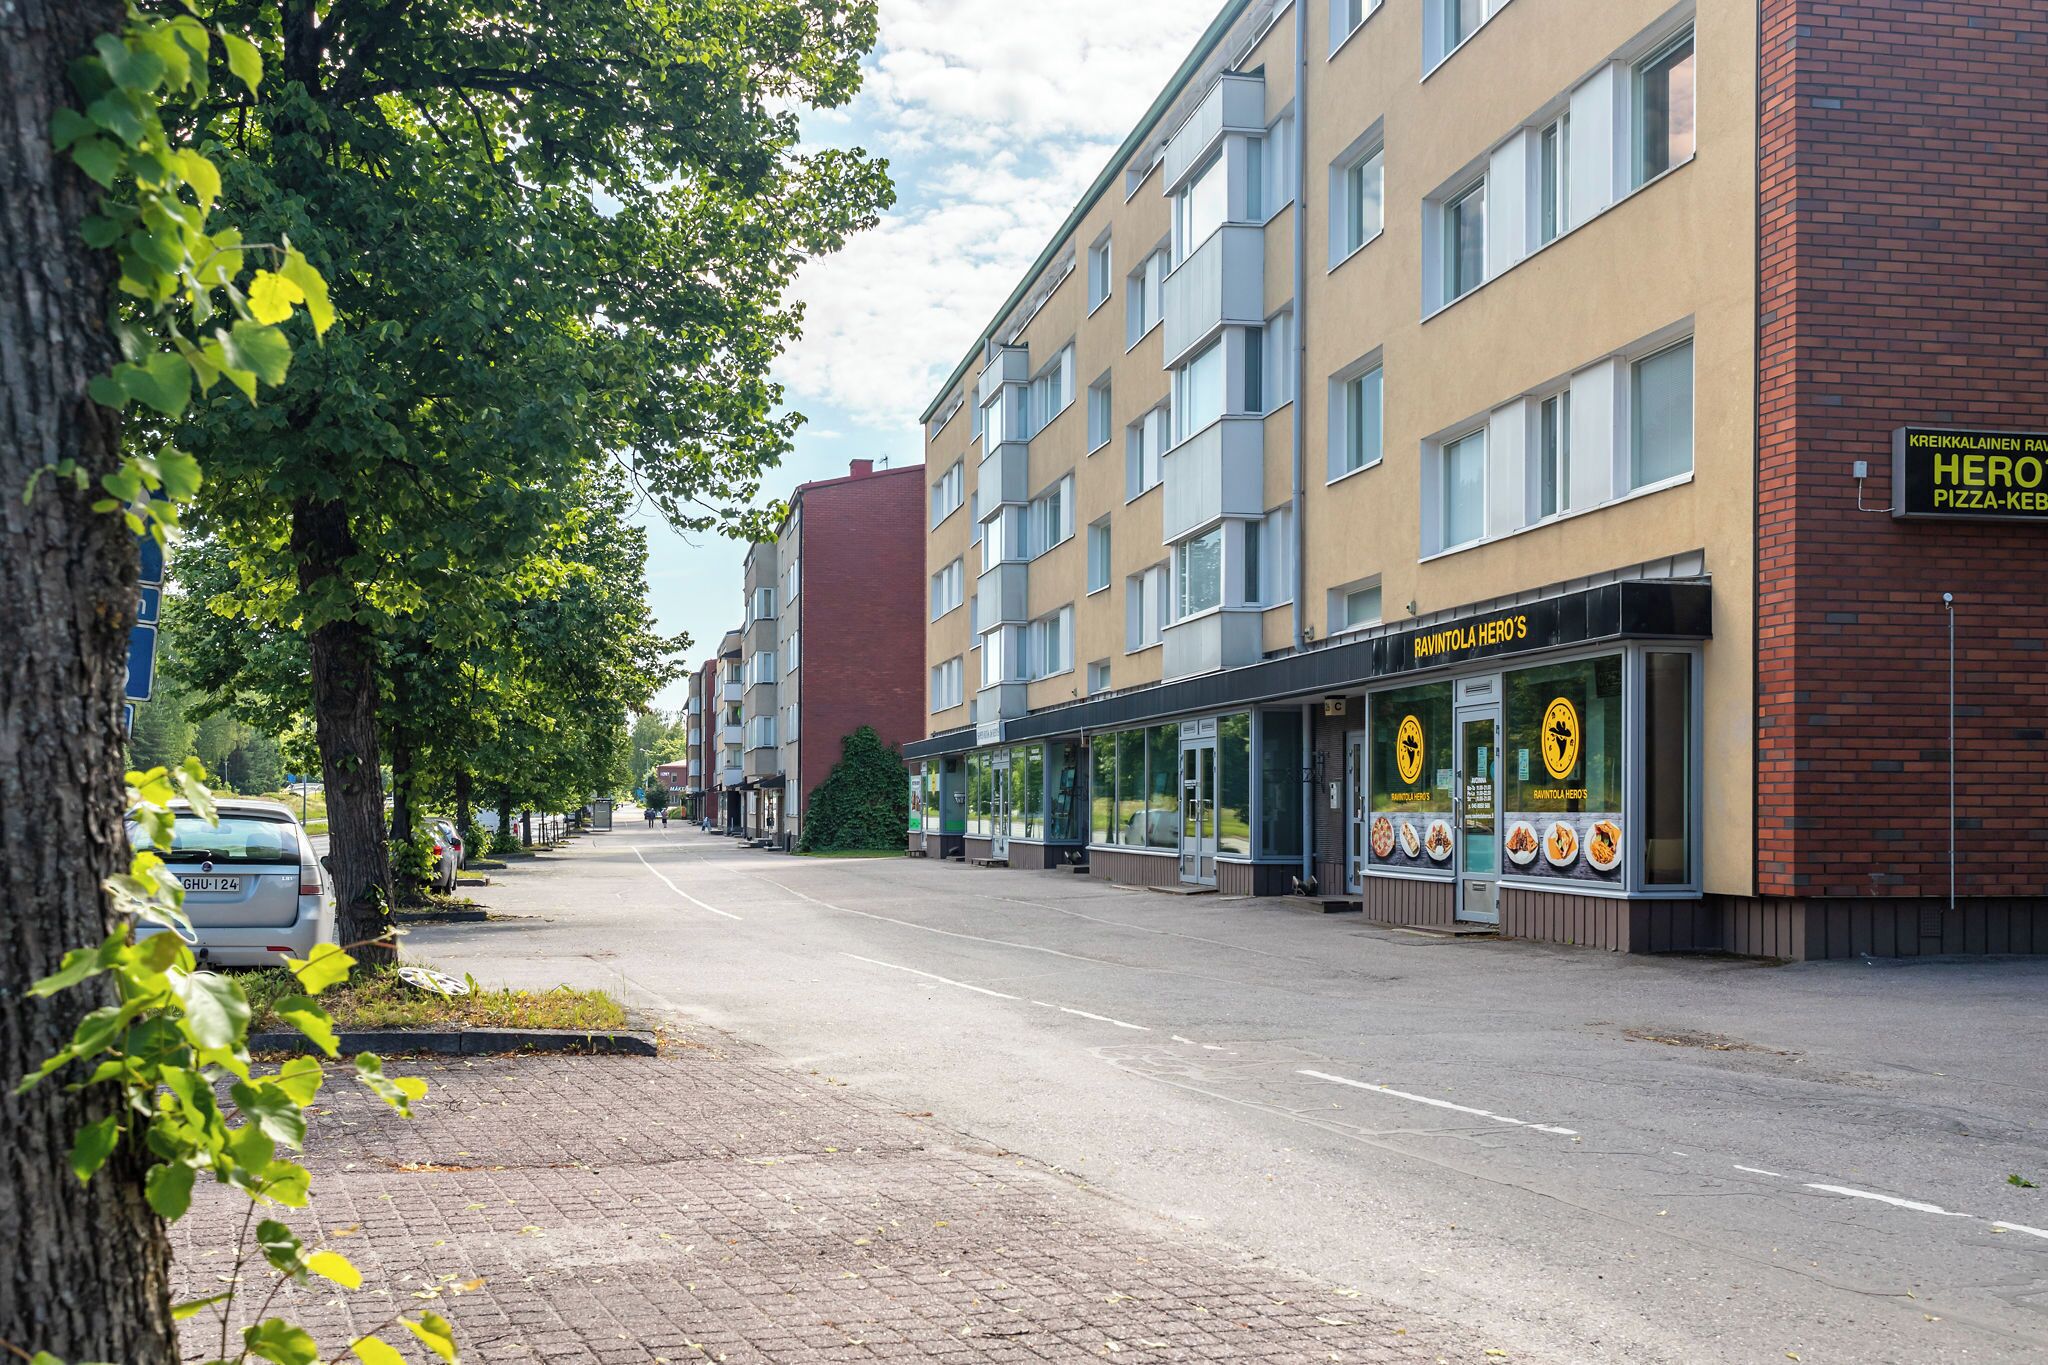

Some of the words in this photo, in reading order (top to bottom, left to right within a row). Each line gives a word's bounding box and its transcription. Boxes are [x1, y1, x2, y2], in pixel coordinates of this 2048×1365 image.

[1910, 434, 2020, 451] KREIKKALAINEN
[1934, 489, 2048, 511] PIZZA-KEB
[1414, 626, 1476, 658] RAVINTOLA
[1335, 702, 1342, 711] C
[1533, 789, 1564, 799] RAVINTOLA
